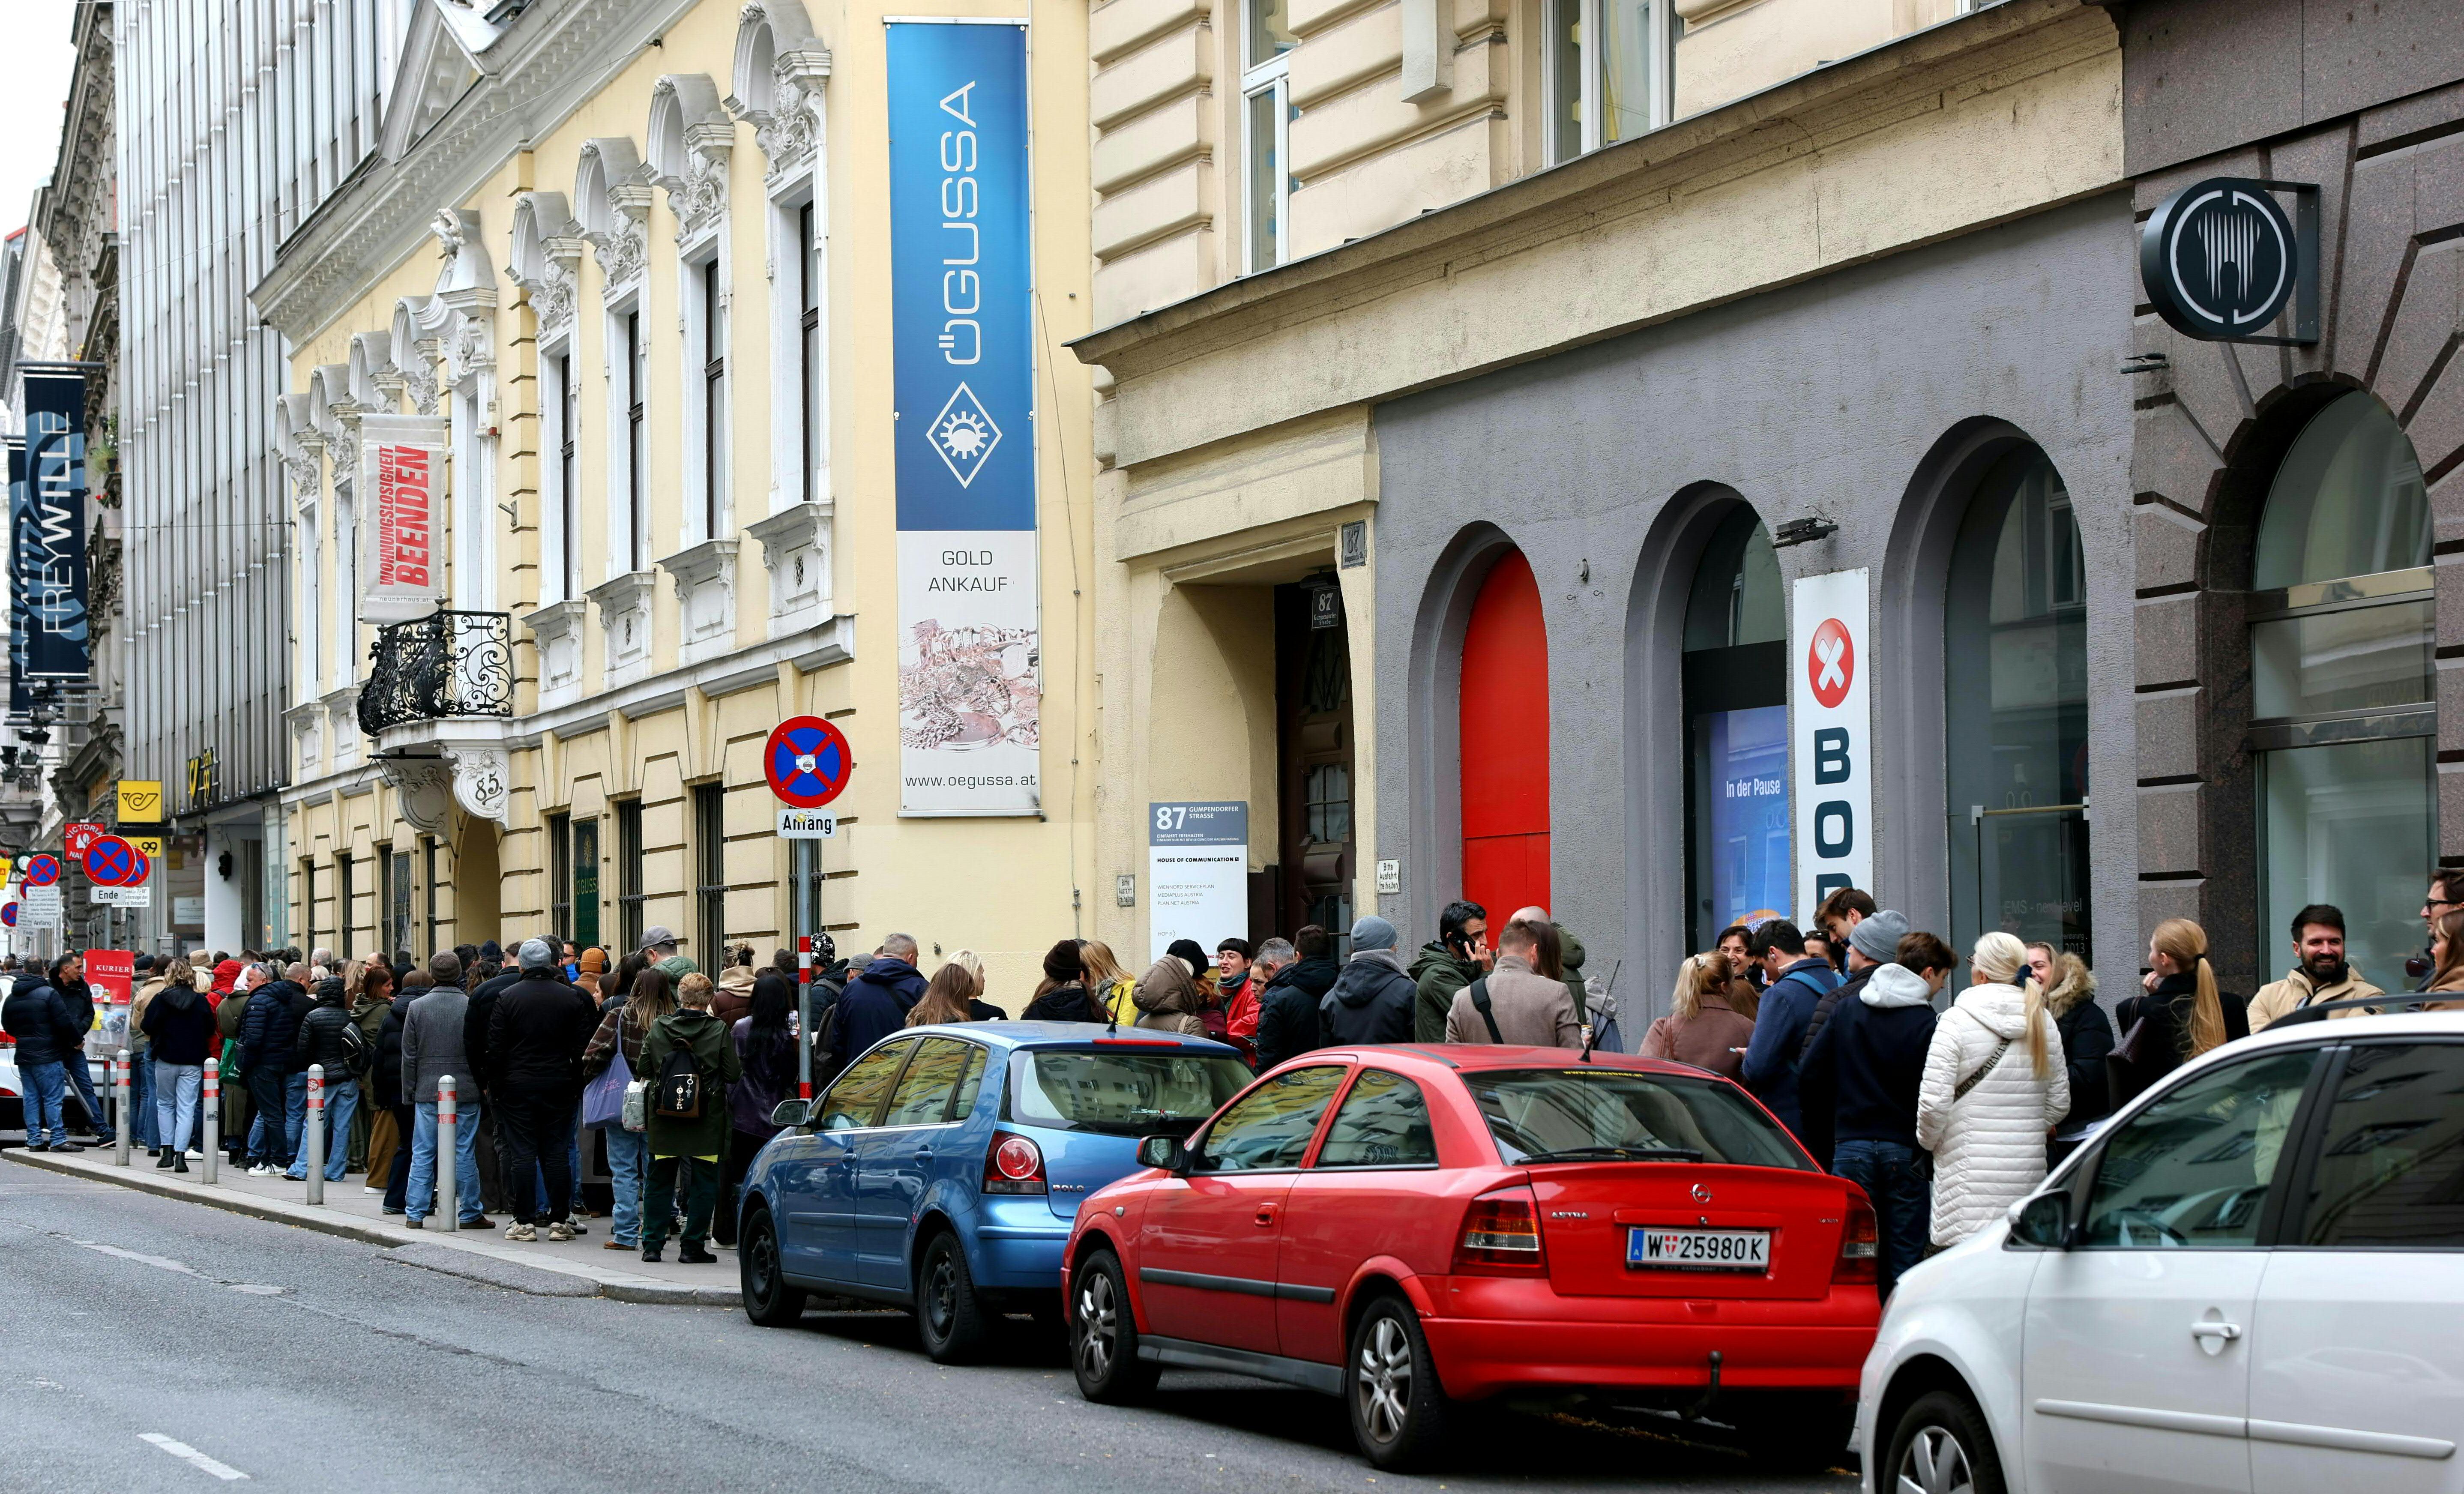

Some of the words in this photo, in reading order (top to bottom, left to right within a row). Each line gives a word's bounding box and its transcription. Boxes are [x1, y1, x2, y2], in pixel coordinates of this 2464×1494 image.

[939, 81, 981, 365] ÖGUSSA
[40, 411, 72, 634] FREYWILLE
[379, 445, 395, 586] WOHNUNGSLOSIGKEIT
[395, 445, 429, 587] BEENDEN
[1347, 525, 1360, 554] 87
[943, 551, 993, 566] GOLD
[928, 577, 1008, 592] ANKAUF
[1319, 593, 1333, 611] 87
[476, 772, 503, 803] 85
[905, 774, 1036, 789] www.oegussa.at
[1726, 781, 1734, 798] In
[1737, 779, 1751, 797] der
[1754, 778, 1780, 796] Pause
[1156, 807, 1186, 830] 87
[66, 824, 102, 839] VICTORIA
[69, 851, 83, 859] NAI
[141, 842, 158, 853] 99
[1383, 863, 1393, 871] Bitte
[1380, 871, 1397, 880] Ausfahrt
[1379, 881, 1398, 890] freihalten
[99, 890, 118, 899] Ende
[2004, 900, 2027, 914] EMS
[2060, 898, 2082, 912] level
[2064, 943, 2085, 954] 2013
[96, 964, 130, 973] KURIER
[1633, 1248, 1640, 1257] A
[1648, 1235, 1663, 1257] W
